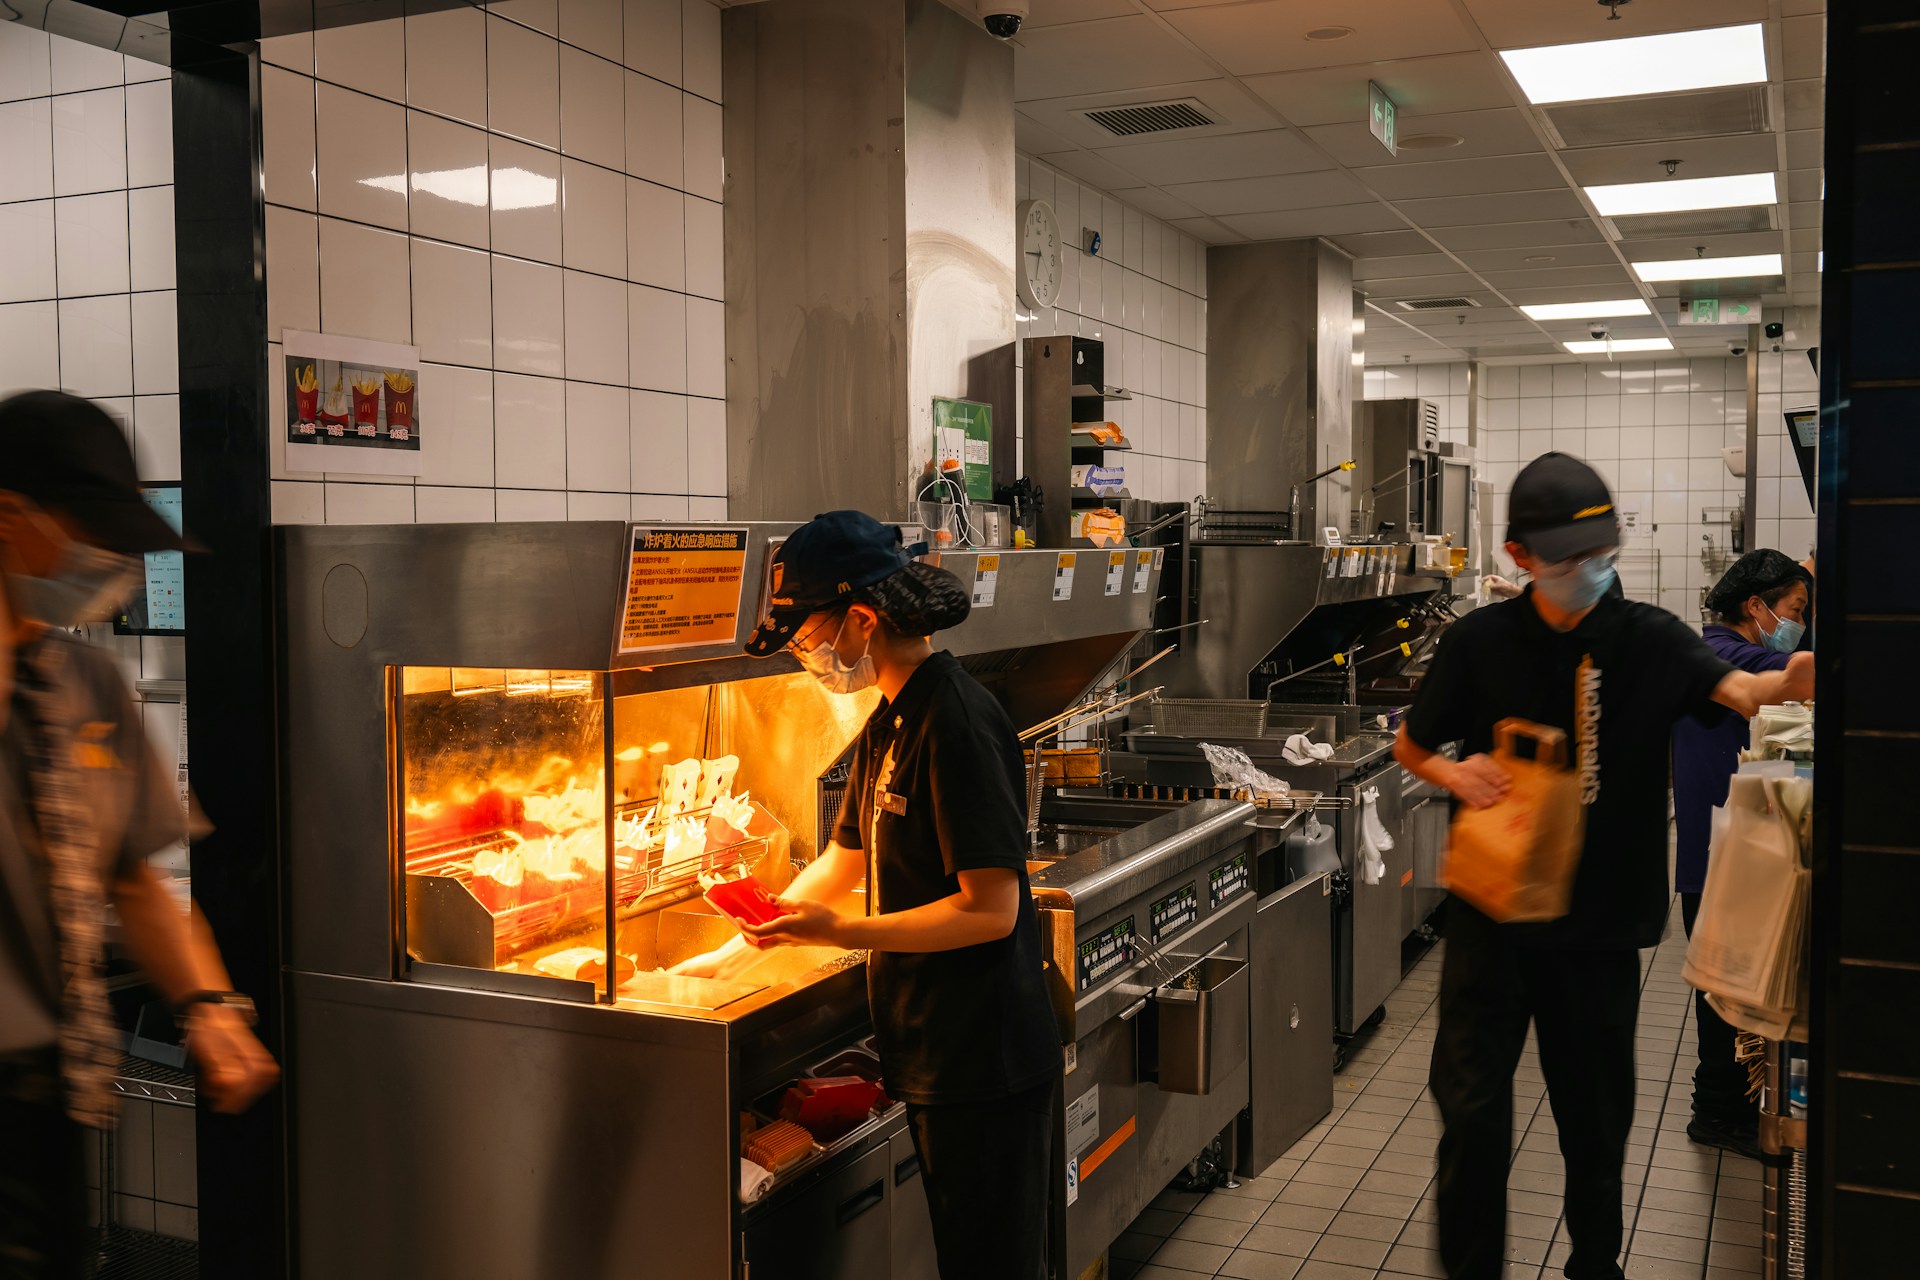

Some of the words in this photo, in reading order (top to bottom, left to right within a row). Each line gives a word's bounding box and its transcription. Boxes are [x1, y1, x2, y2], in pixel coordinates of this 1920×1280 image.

[1036, 210, 1042, 224] 12
[1048, 234, 1053, 247] 2
[1050, 254, 1055, 267] 3
[1043, 284, 1048, 297] 5
[644, 533, 738, 548] 炸炉着火的应急响应措施
[1581, 667, 1602, 805] McDonald's
